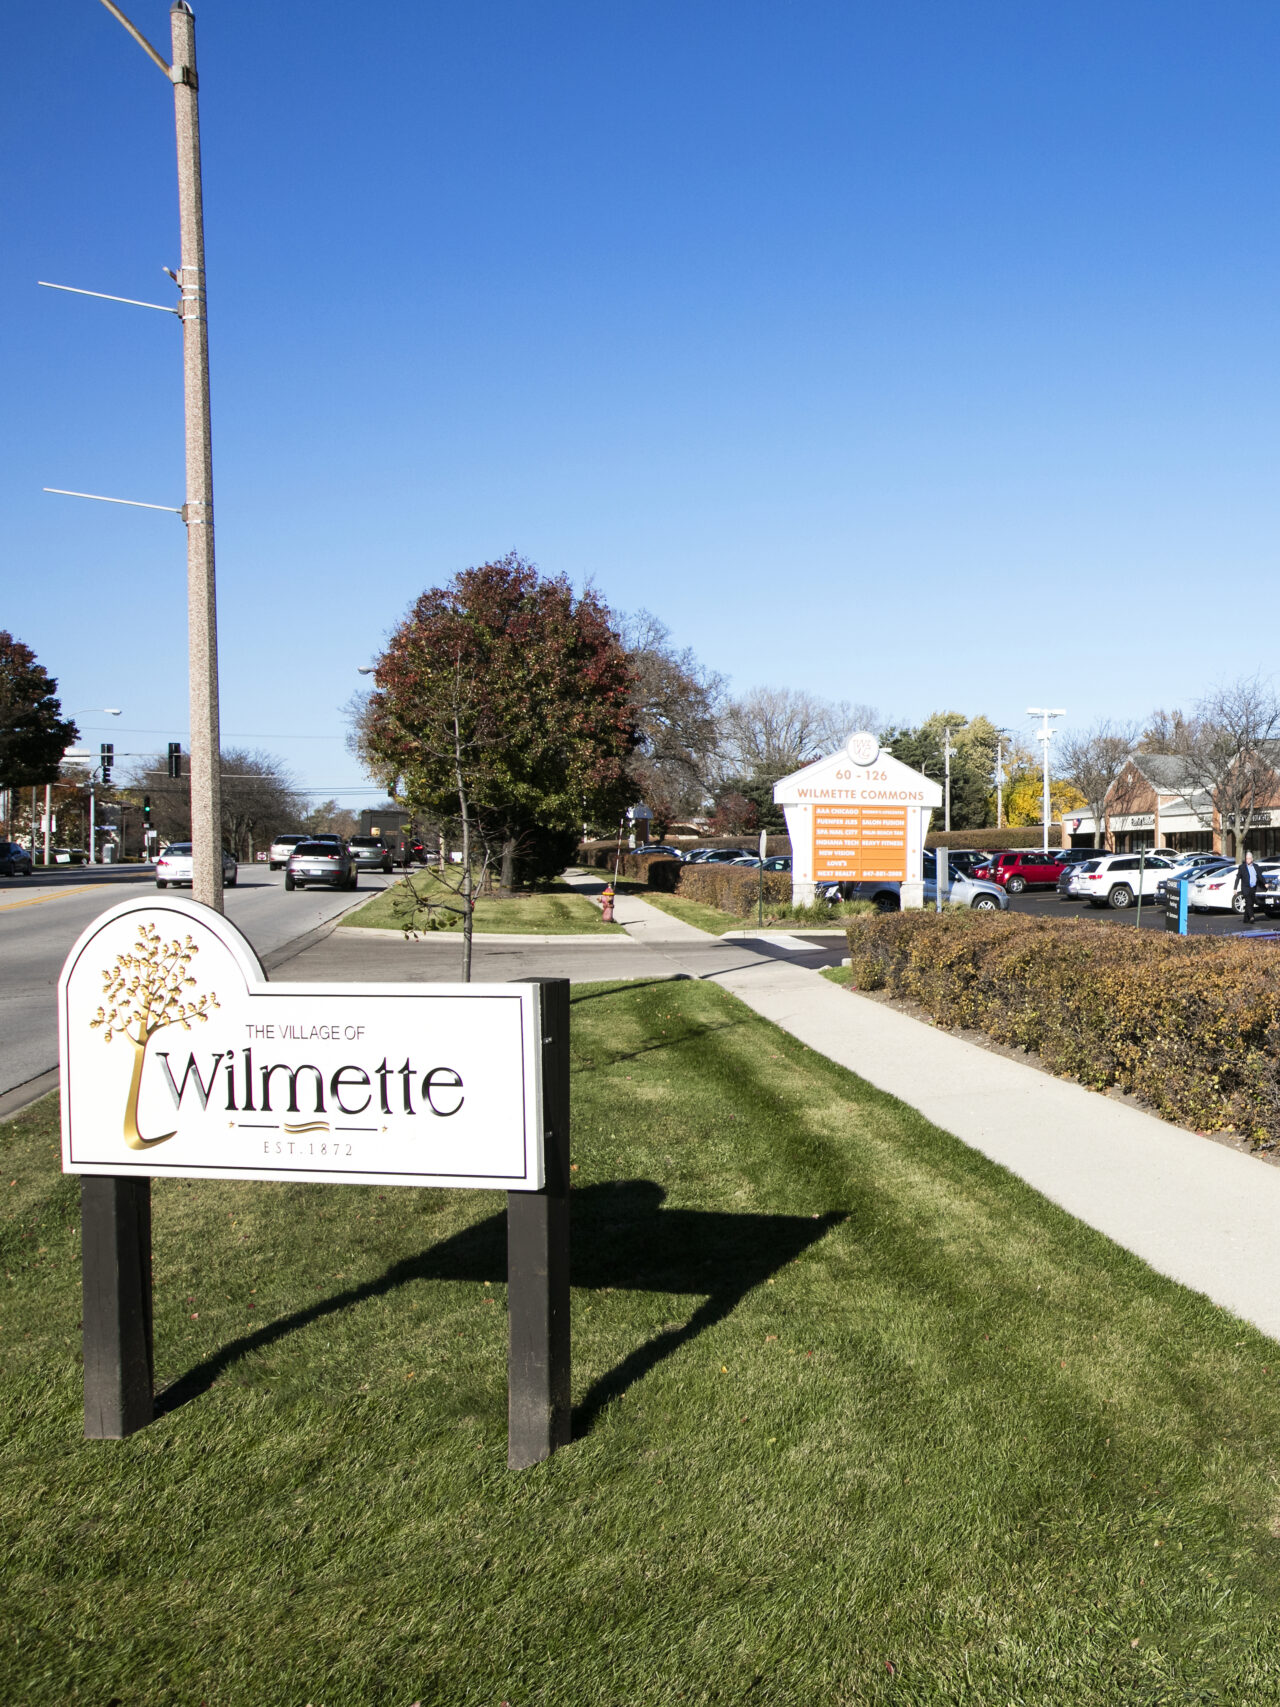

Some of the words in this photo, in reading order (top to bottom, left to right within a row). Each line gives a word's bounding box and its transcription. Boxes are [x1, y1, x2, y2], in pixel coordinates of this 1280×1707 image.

[835, 769, 852, 780] 60
[865, 770, 888, 781] 126
[797, 788, 857, 799] WILMETTE
[860, 790, 924, 801] COMMONS
[245, 1023, 276, 1040] THE
[279, 1024, 342, 1041] VILLAGE
[344, 1024, 366, 1041] OF
[154, 1047, 466, 1118] Wilmette
